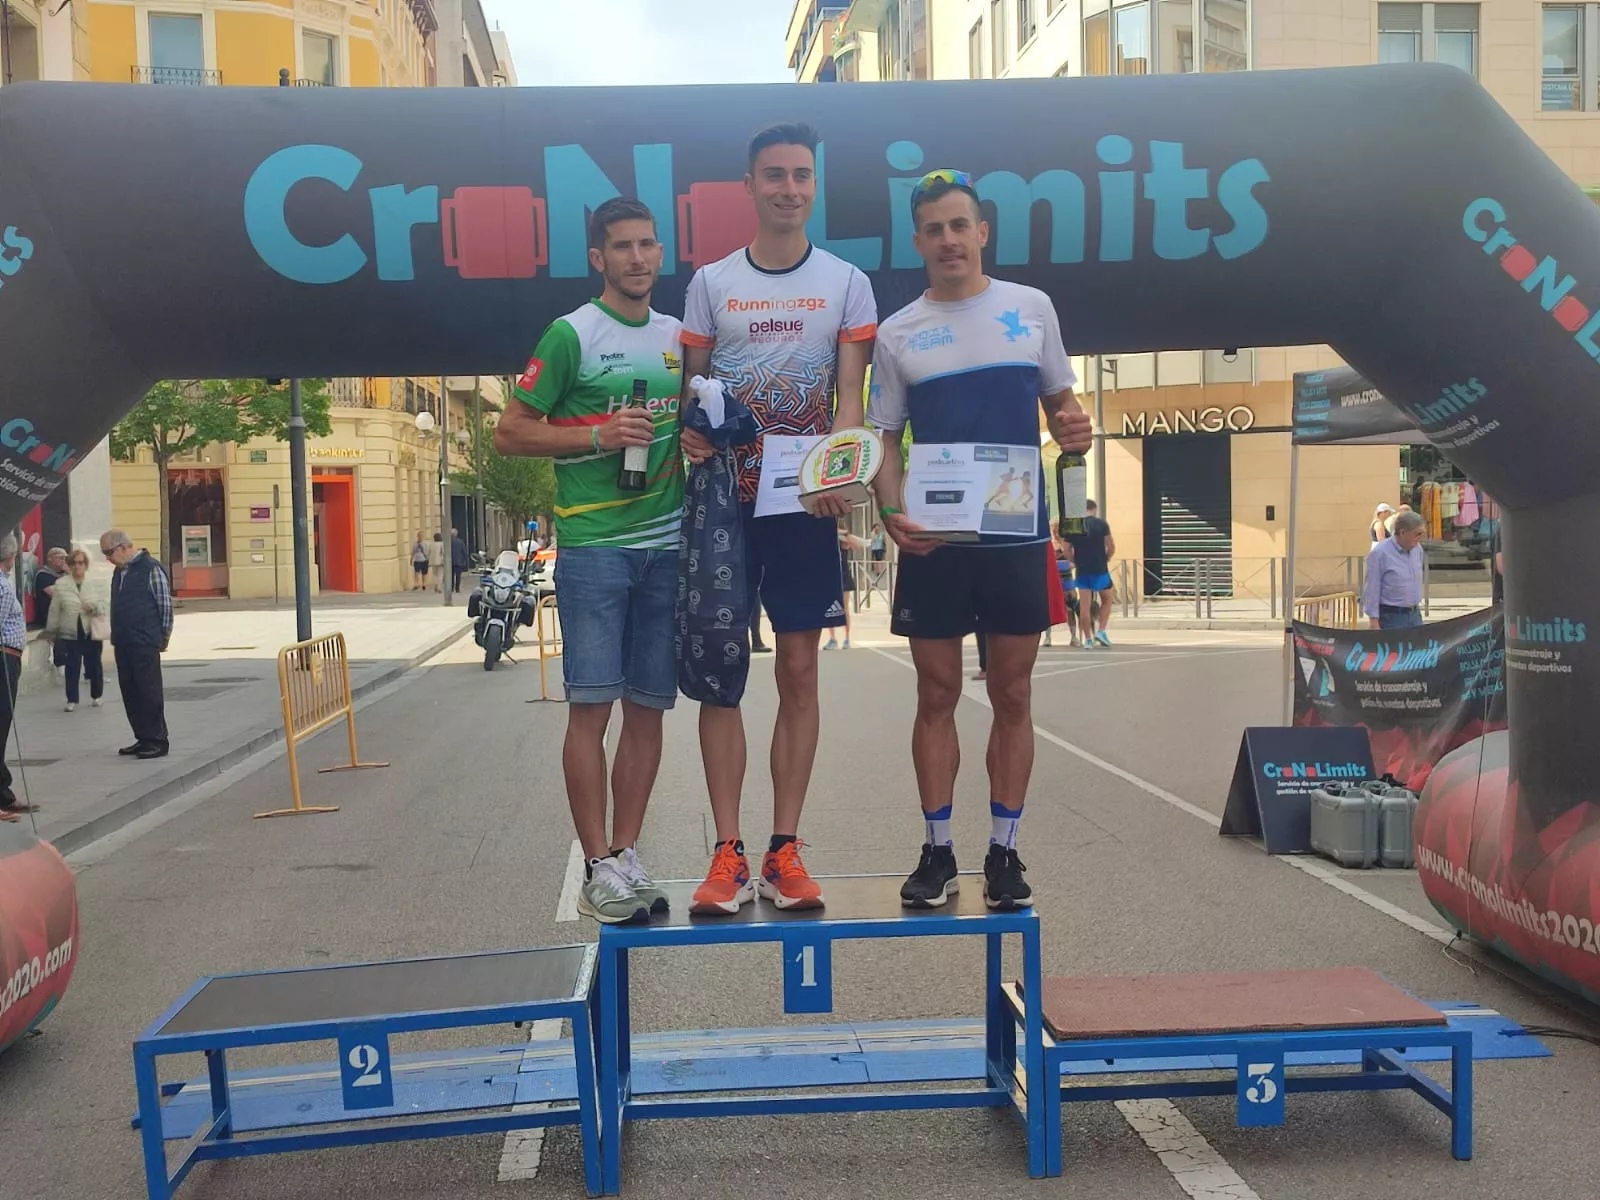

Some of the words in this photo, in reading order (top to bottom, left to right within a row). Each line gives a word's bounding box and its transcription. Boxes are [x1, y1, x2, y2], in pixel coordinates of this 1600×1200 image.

[727, 297, 826, 312] Runningzgz
[910, 334, 953, 352] TEAM
[1122, 405, 1254, 436] MANGO
[1528, 662, 1573, 673] deportivos
[1554, 651, 1561, 660] y
[795, 946, 818, 987] 1
[349, 1044, 383, 1088] 2
[1246, 1063, 1277, 1104] 3
